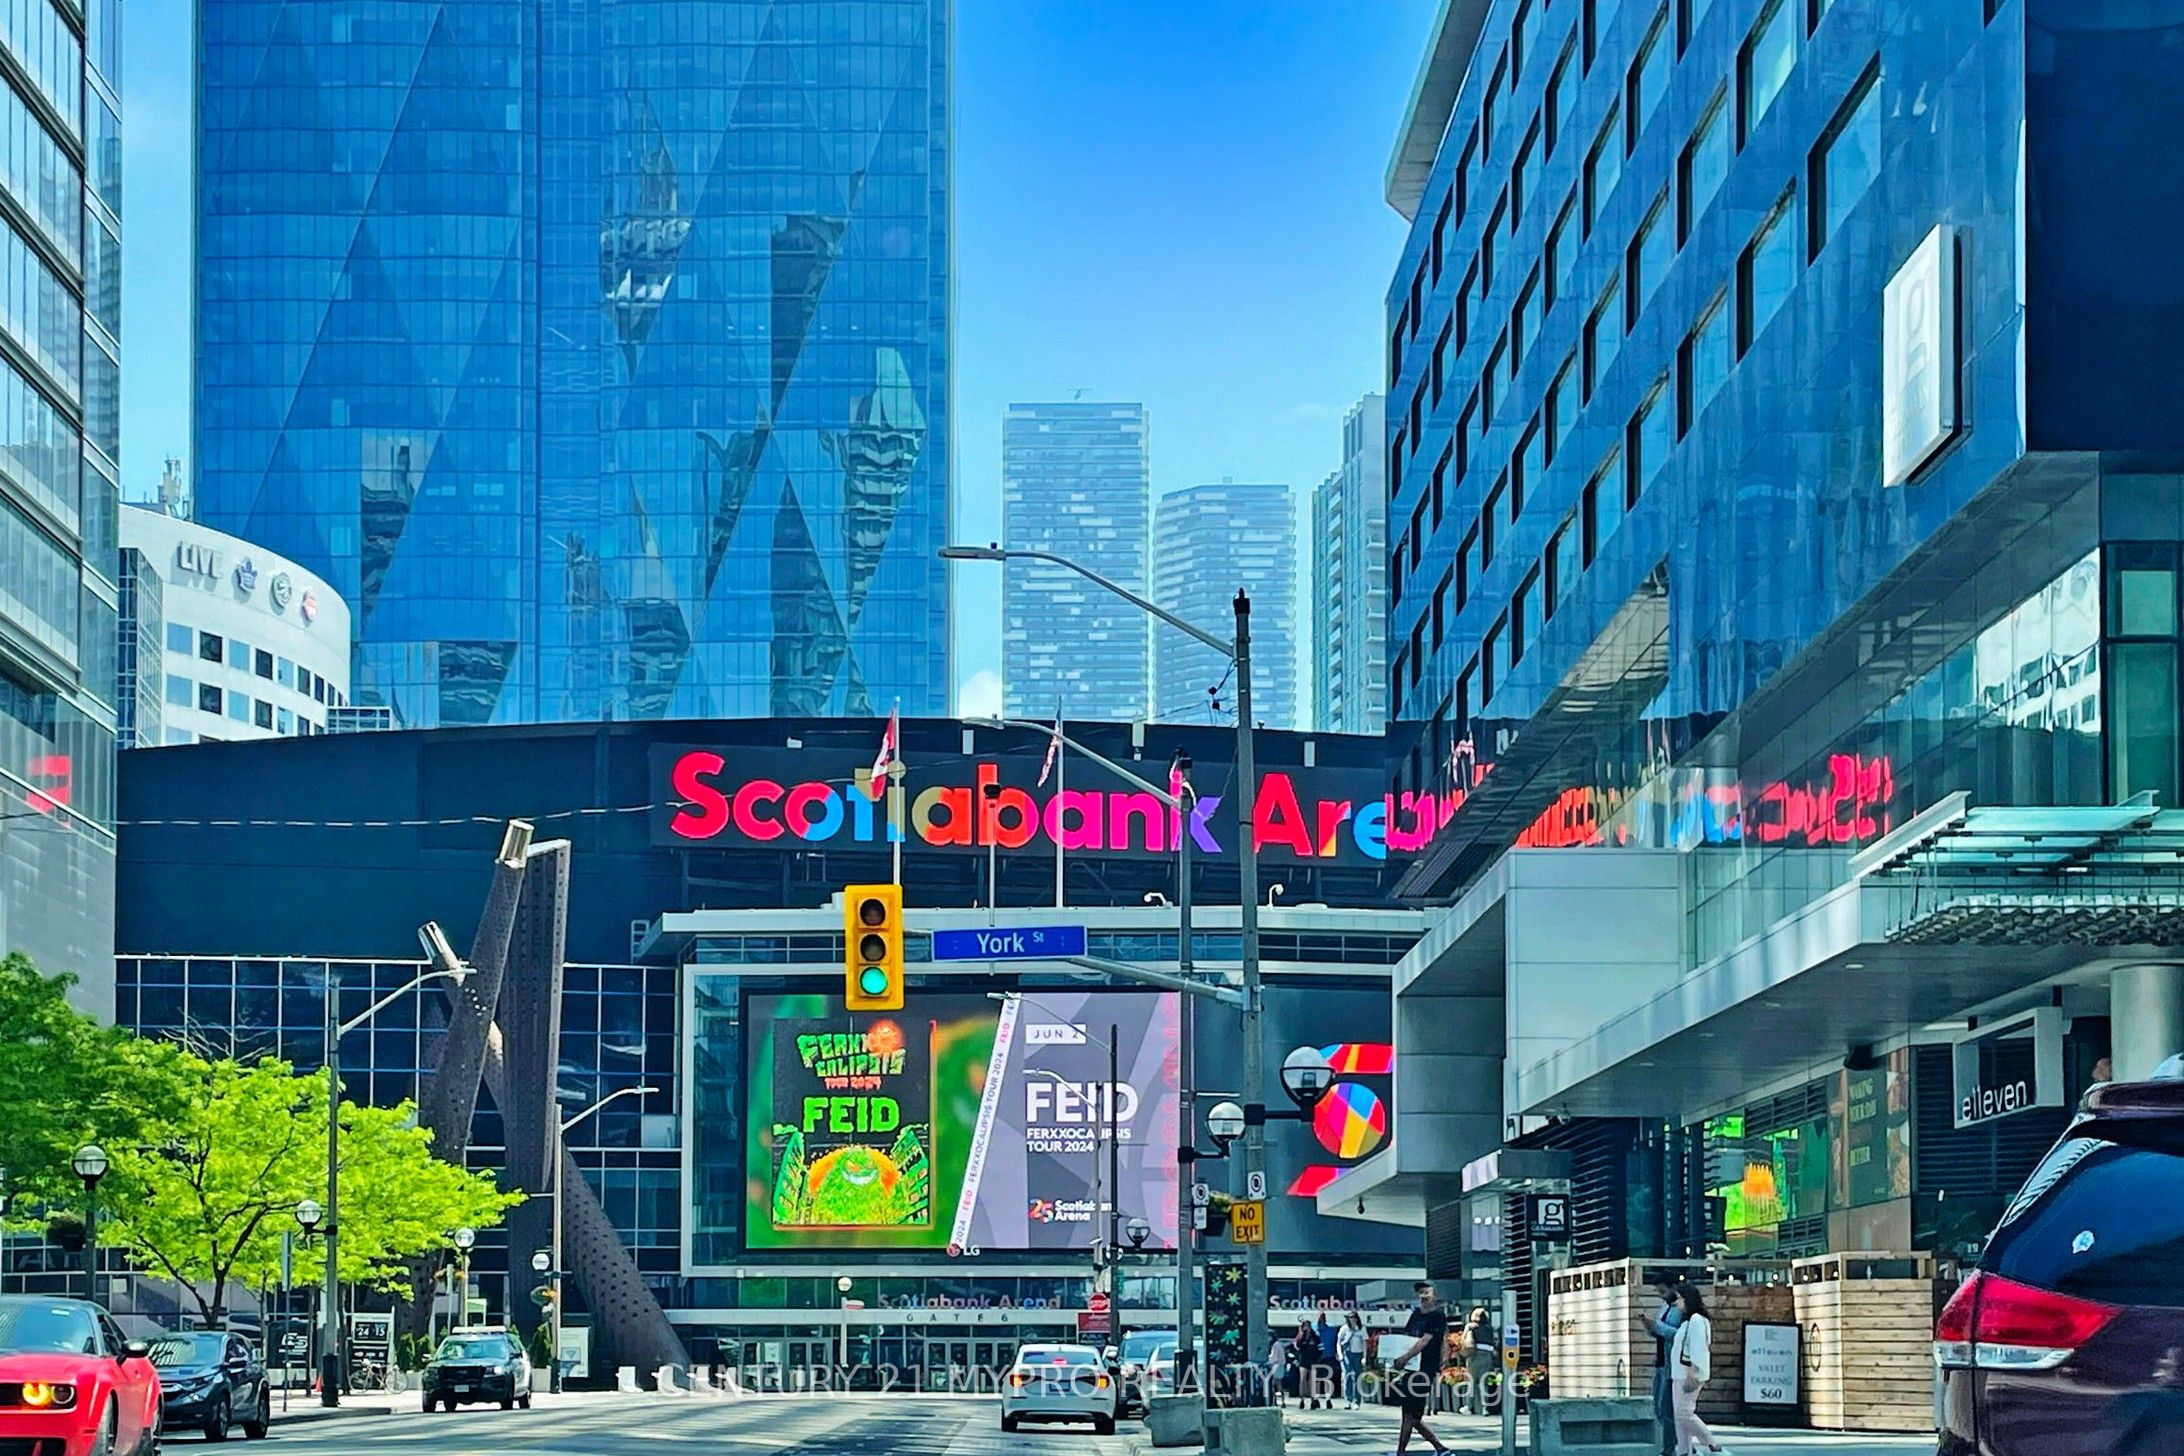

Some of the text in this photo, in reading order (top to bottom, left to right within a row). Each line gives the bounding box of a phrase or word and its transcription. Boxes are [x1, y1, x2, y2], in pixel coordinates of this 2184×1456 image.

[177, 541, 223, 580] LIVE
[671, 751, 1222, 853] Scotiabank
[976, 931, 1044, 954] York St
[1034, 1029, 1063, 1039] JUN
[987, 1078, 999, 1103] TOUR
[1026, 1082, 1139, 1122] FEID
[1962, 1081, 2027, 1120] elleven
[803, 1097, 900, 1133] FEID
[1026, 1141, 1095, 1152] TOUR 2024
[1029, 1199, 1055, 1223] 25
[1055, 1211, 1090, 1221] Arena
[1240, 1207, 1255, 1220] NO
[1236, 1225, 1260, 1239] EXIT
[963, 1245, 980, 1256] LG
[878, 1294, 1061, 1309] Scotiabank Arena
[907, 1313, 984, 1322] GATE
[1761, 1388, 1783, 1400] $60
